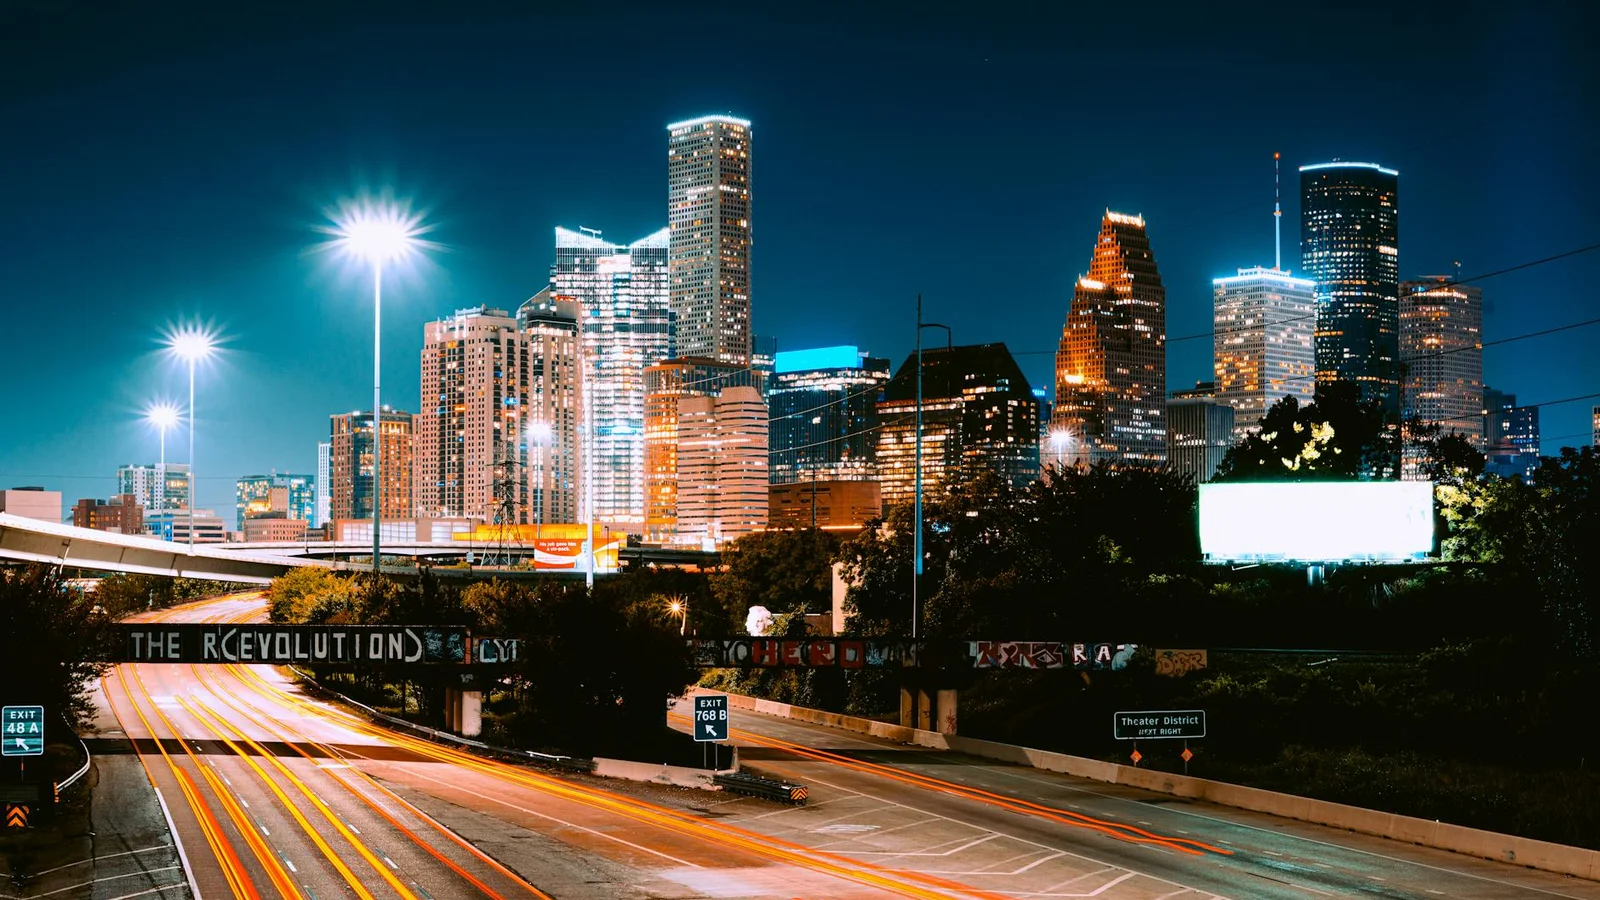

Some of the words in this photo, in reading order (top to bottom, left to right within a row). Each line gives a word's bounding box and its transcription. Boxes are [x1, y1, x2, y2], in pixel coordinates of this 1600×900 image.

[131, 632, 180, 659] THE
[700, 699, 722, 707] EXIT
[10, 710, 36, 719] EXIT
[696, 710, 717, 721] 768
[719, 709, 726, 720] B
[1121, 717, 1160, 726] Theater
[1163, 716, 1199, 725] District
[7, 722, 25, 733] 48
[29, 722, 39, 733] A
[1138, 728, 1157, 736] NEXT
